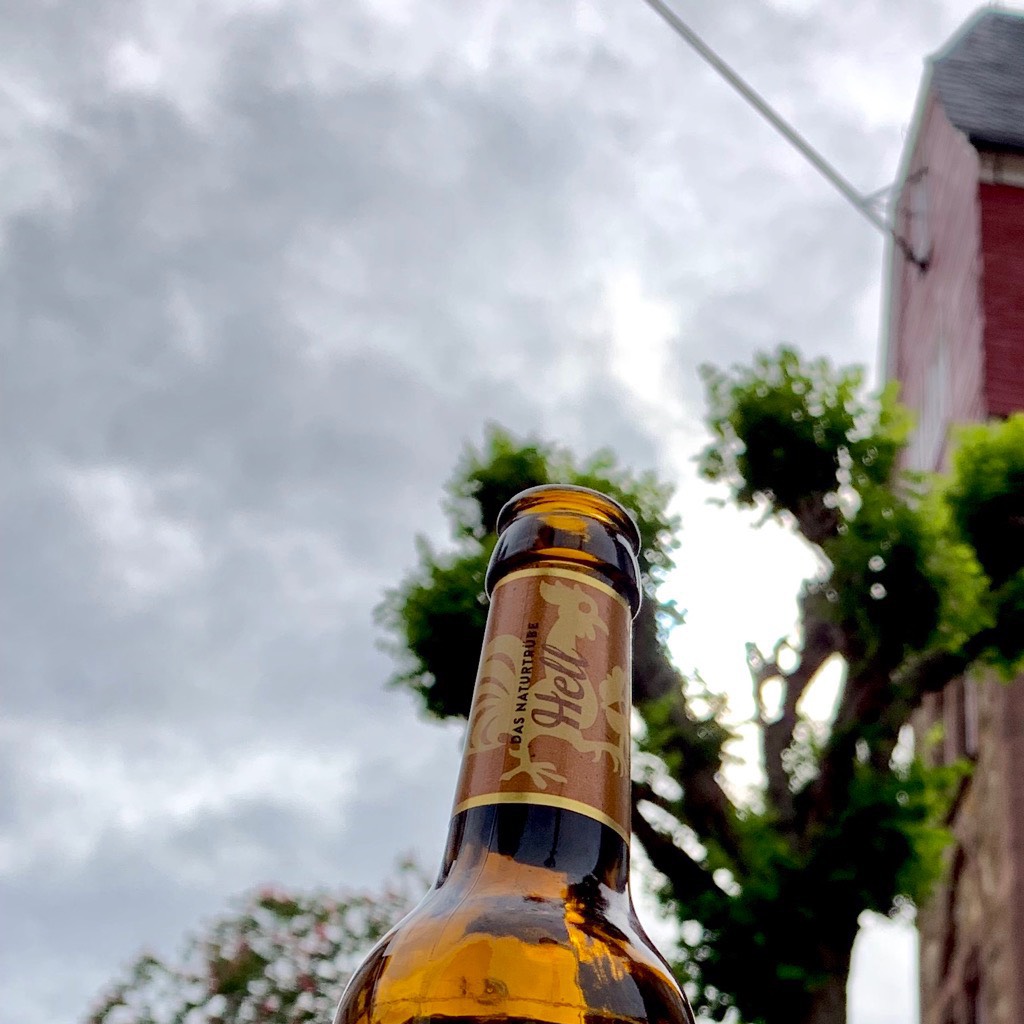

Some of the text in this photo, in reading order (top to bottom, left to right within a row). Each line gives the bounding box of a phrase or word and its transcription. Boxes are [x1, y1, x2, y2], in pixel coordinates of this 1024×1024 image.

[511, 622, 539, 744] DAS NATURTRÜBE
[531, 643, 589, 730] Hell
